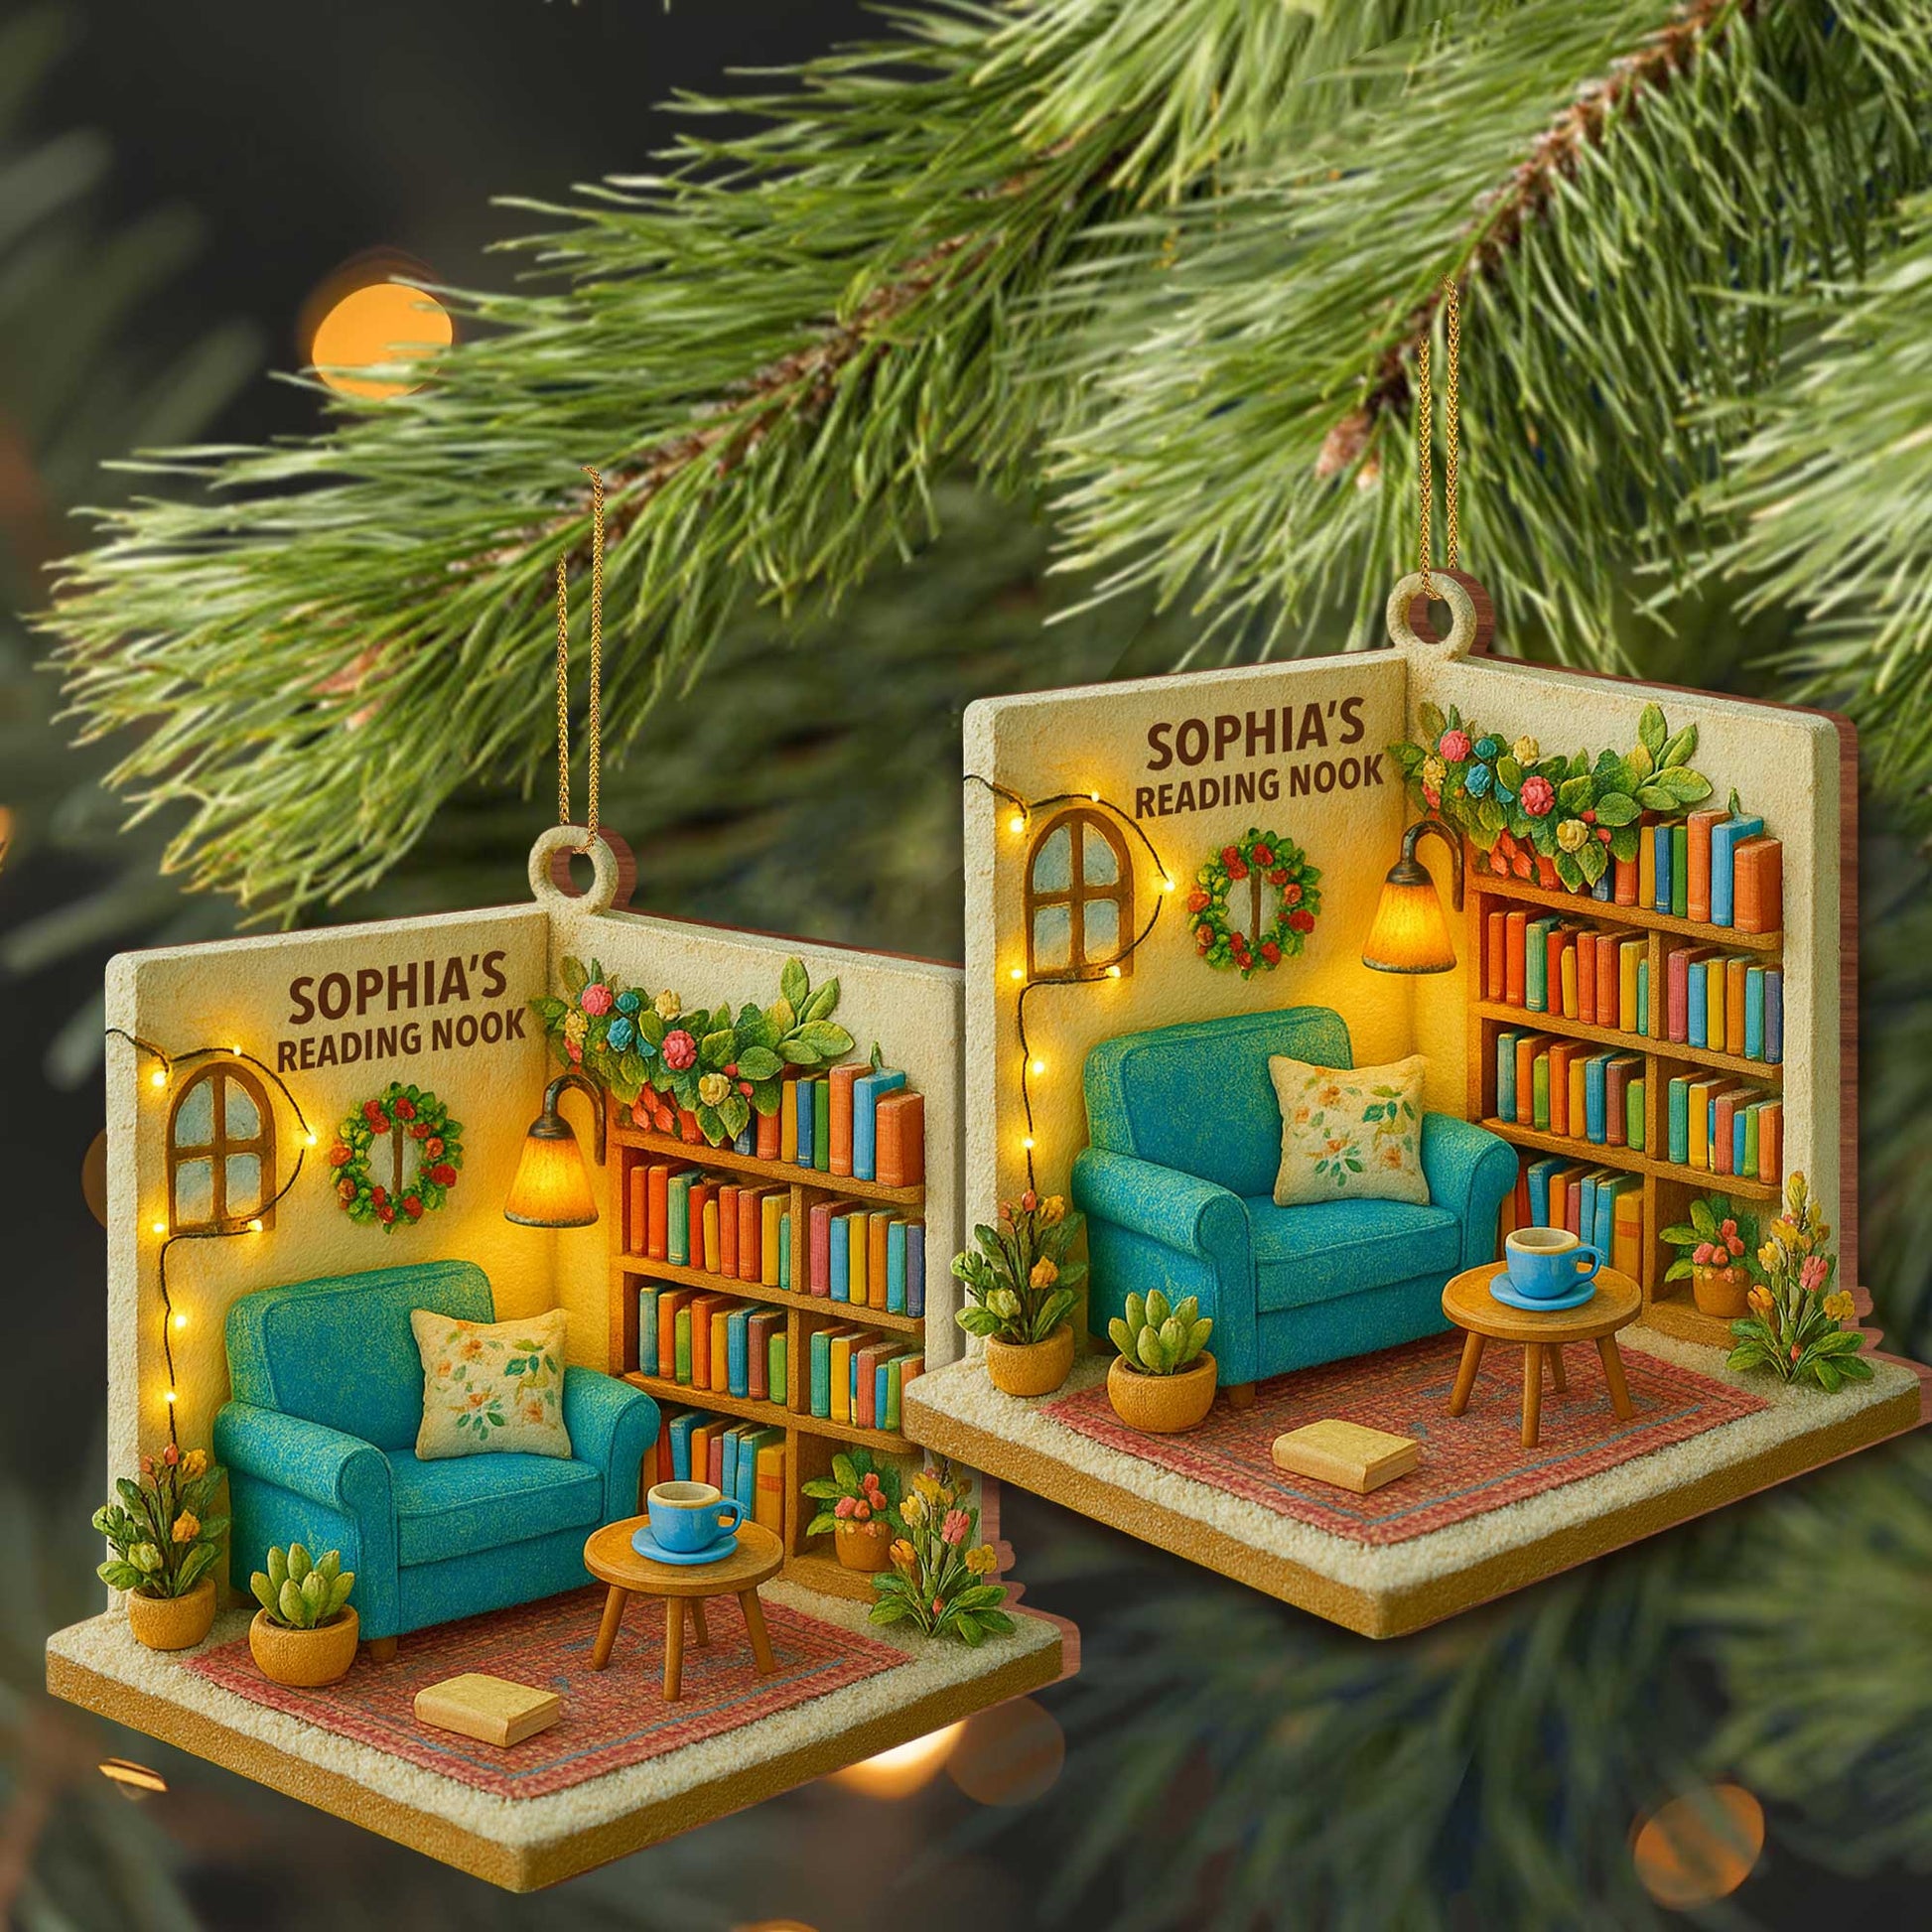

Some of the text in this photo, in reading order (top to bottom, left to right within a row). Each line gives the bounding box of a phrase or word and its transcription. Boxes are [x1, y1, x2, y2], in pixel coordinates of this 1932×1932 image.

[1146, 696, 1366, 771] SOPHIA'S
[1135, 753, 1385, 820] READING NOOK
[288, 950, 507, 1026] SOPHIA'S
[277, 1007, 528, 1073] READING NOOK
